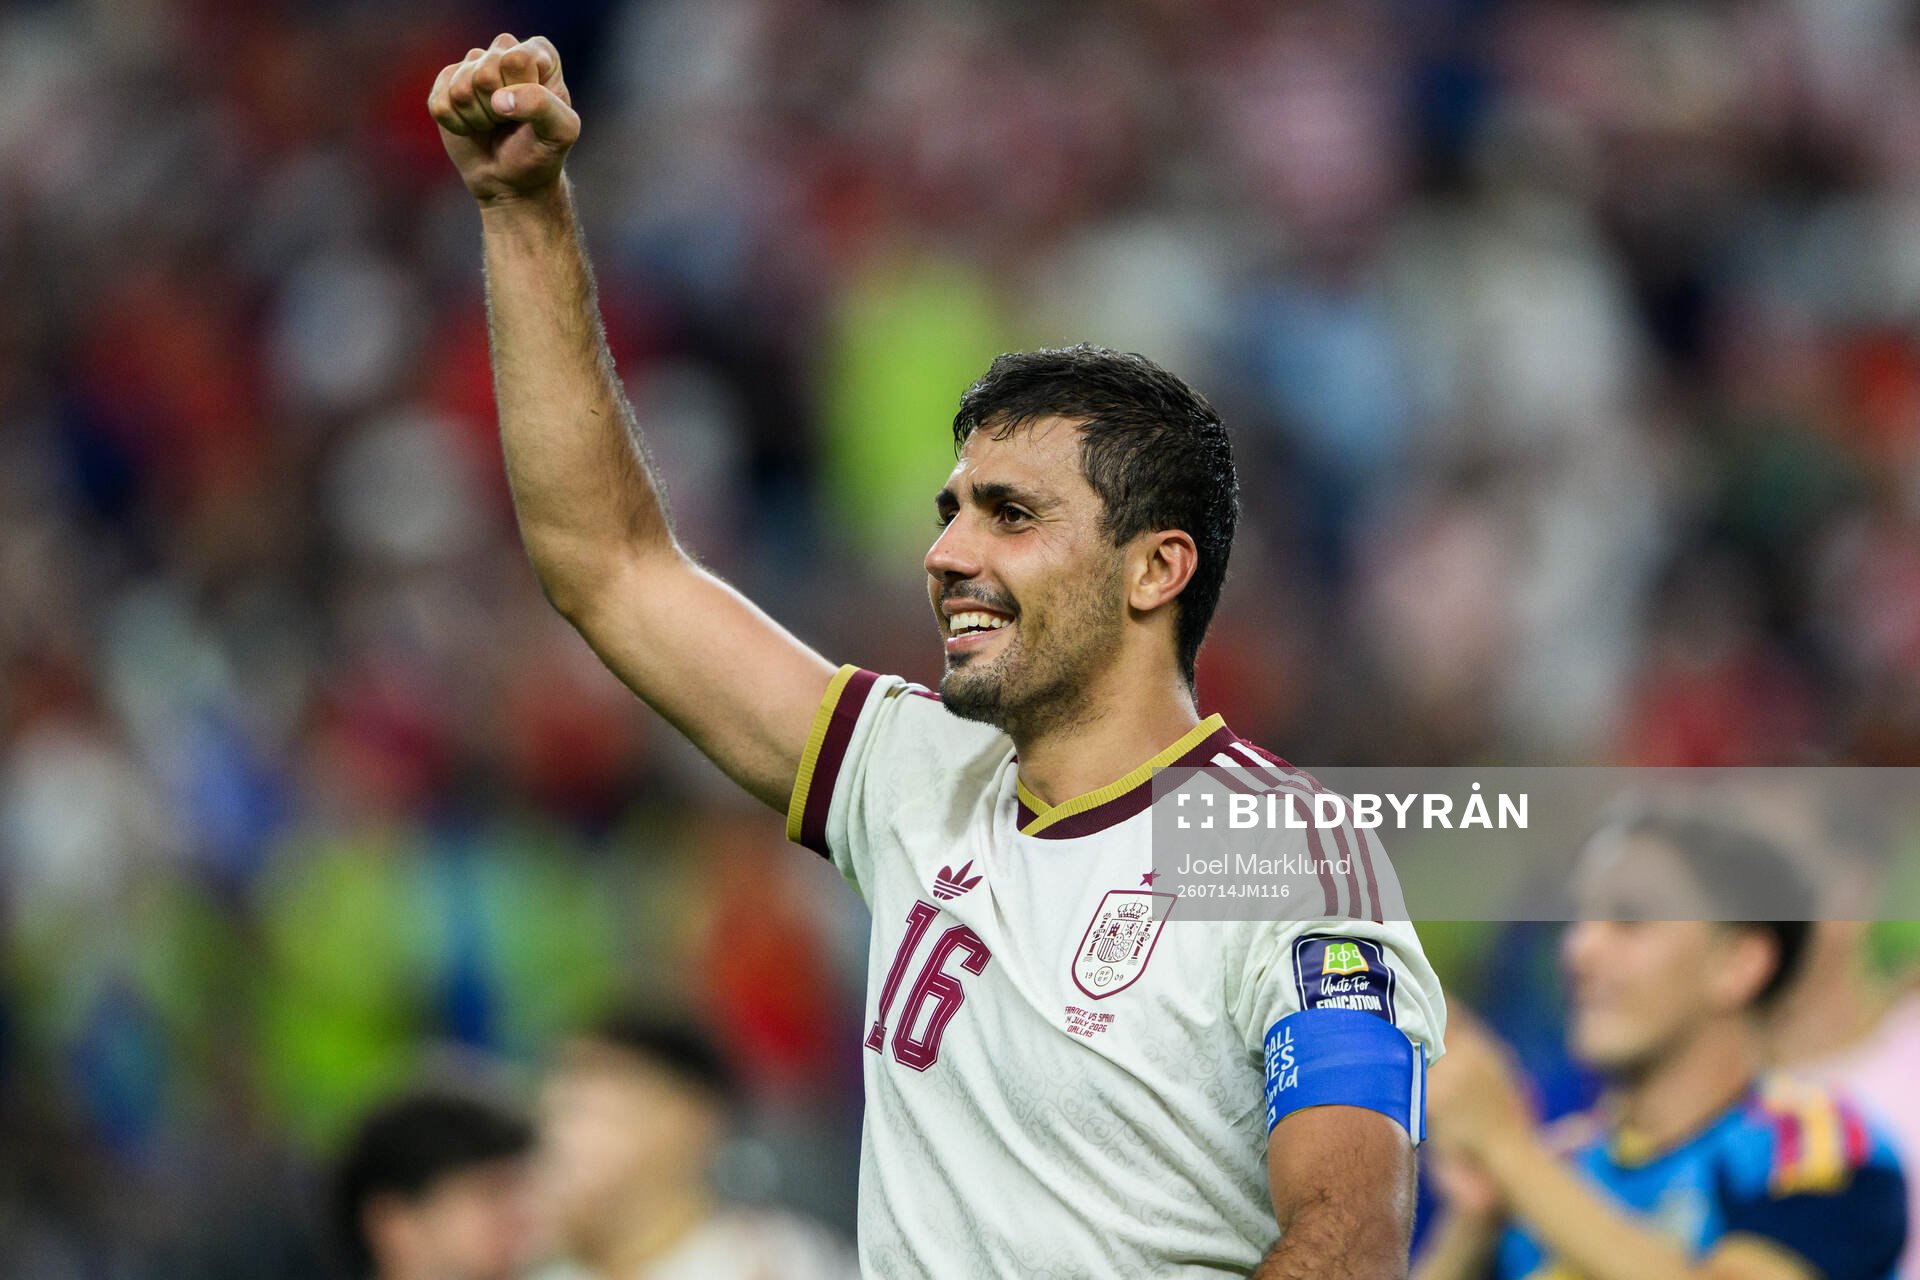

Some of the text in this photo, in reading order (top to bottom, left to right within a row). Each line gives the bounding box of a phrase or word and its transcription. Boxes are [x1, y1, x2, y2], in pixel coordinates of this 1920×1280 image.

[864, 899, 992, 1073] 16
[1321, 975, 1370, 997] Unite For
[1065, 1006, 1115, 1023] FRANCE VS SPAIN
[1067, 1025, 1094, 1038] DALLAS
[1071, 1016, 1089, 1027] JULY
[1088, 1022, 1108, 1033] 2026
